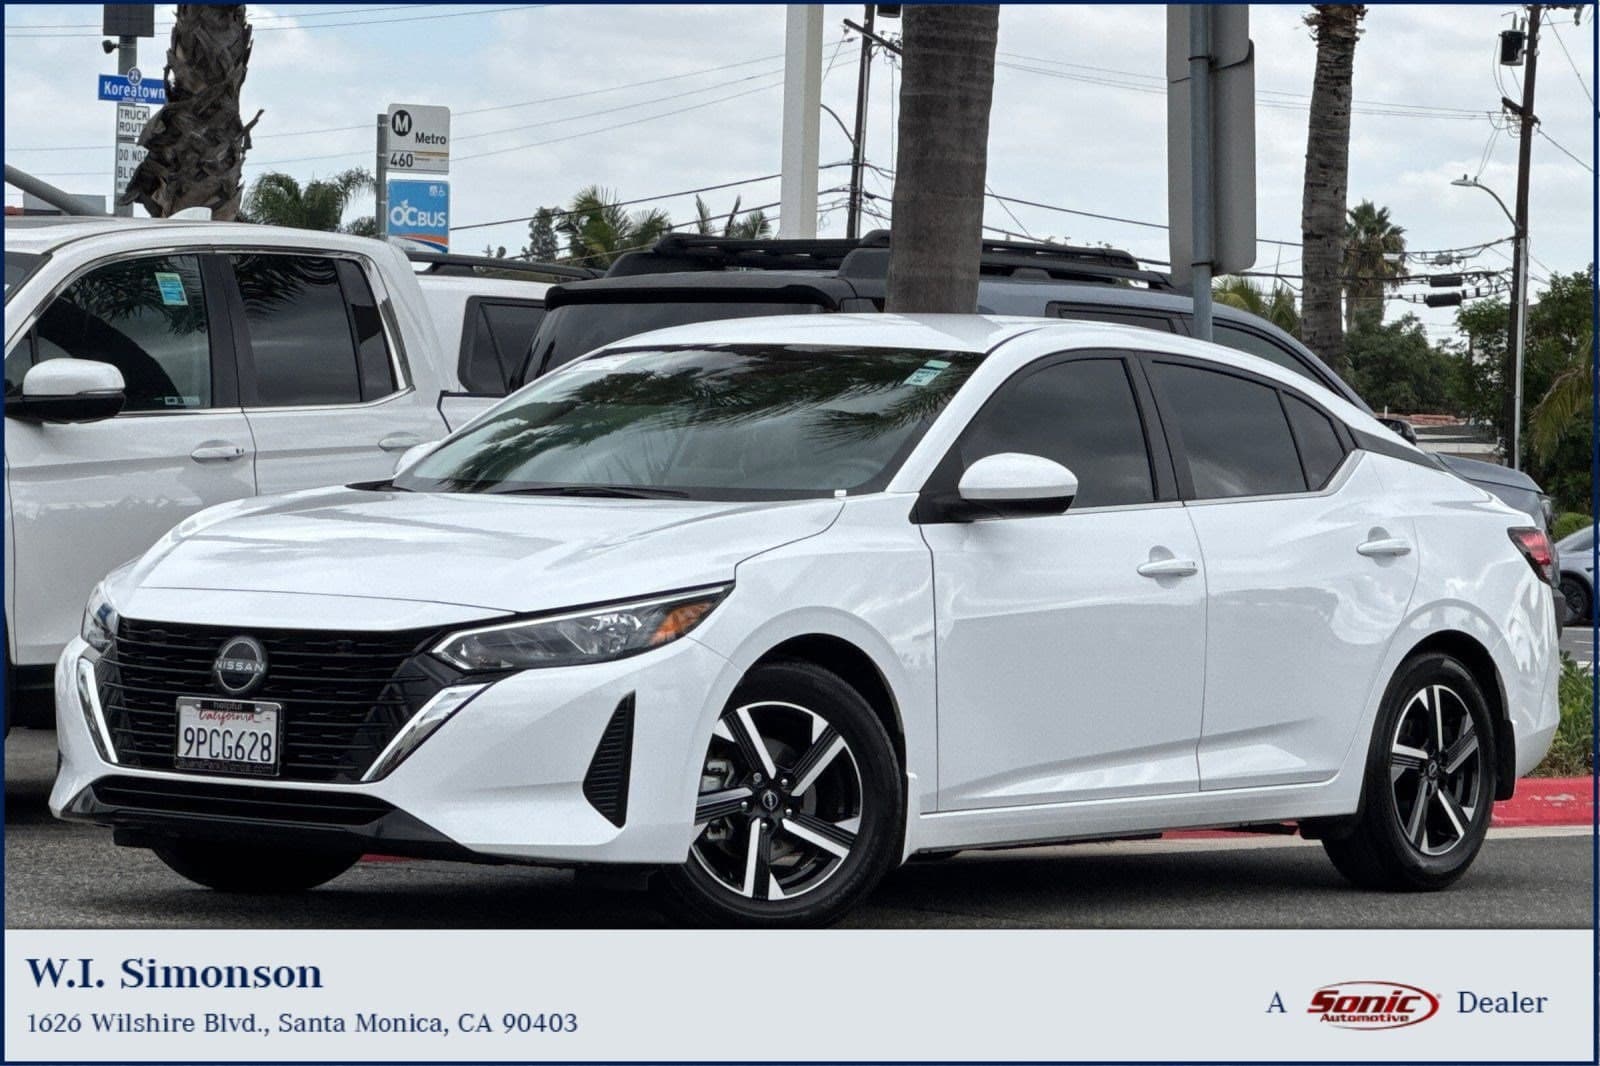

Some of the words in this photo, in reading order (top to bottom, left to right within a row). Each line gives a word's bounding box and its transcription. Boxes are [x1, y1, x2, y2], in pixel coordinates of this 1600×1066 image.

[104, 80, 165, 99] Koreatown
[119, 109, 147, 120] TRUCK
[119, 122, 145, 133] ROUT
[393, 114, 410, 133] M
[415, 132, 447, 145] Metro
[118, 148, 128, 161] DO
[390, 152, 414, 168] 460
[214, 659, 265, 672] NISSAN
[199, 709, 257, 726] California
[184, 726, 272, 762] 9PCG628
